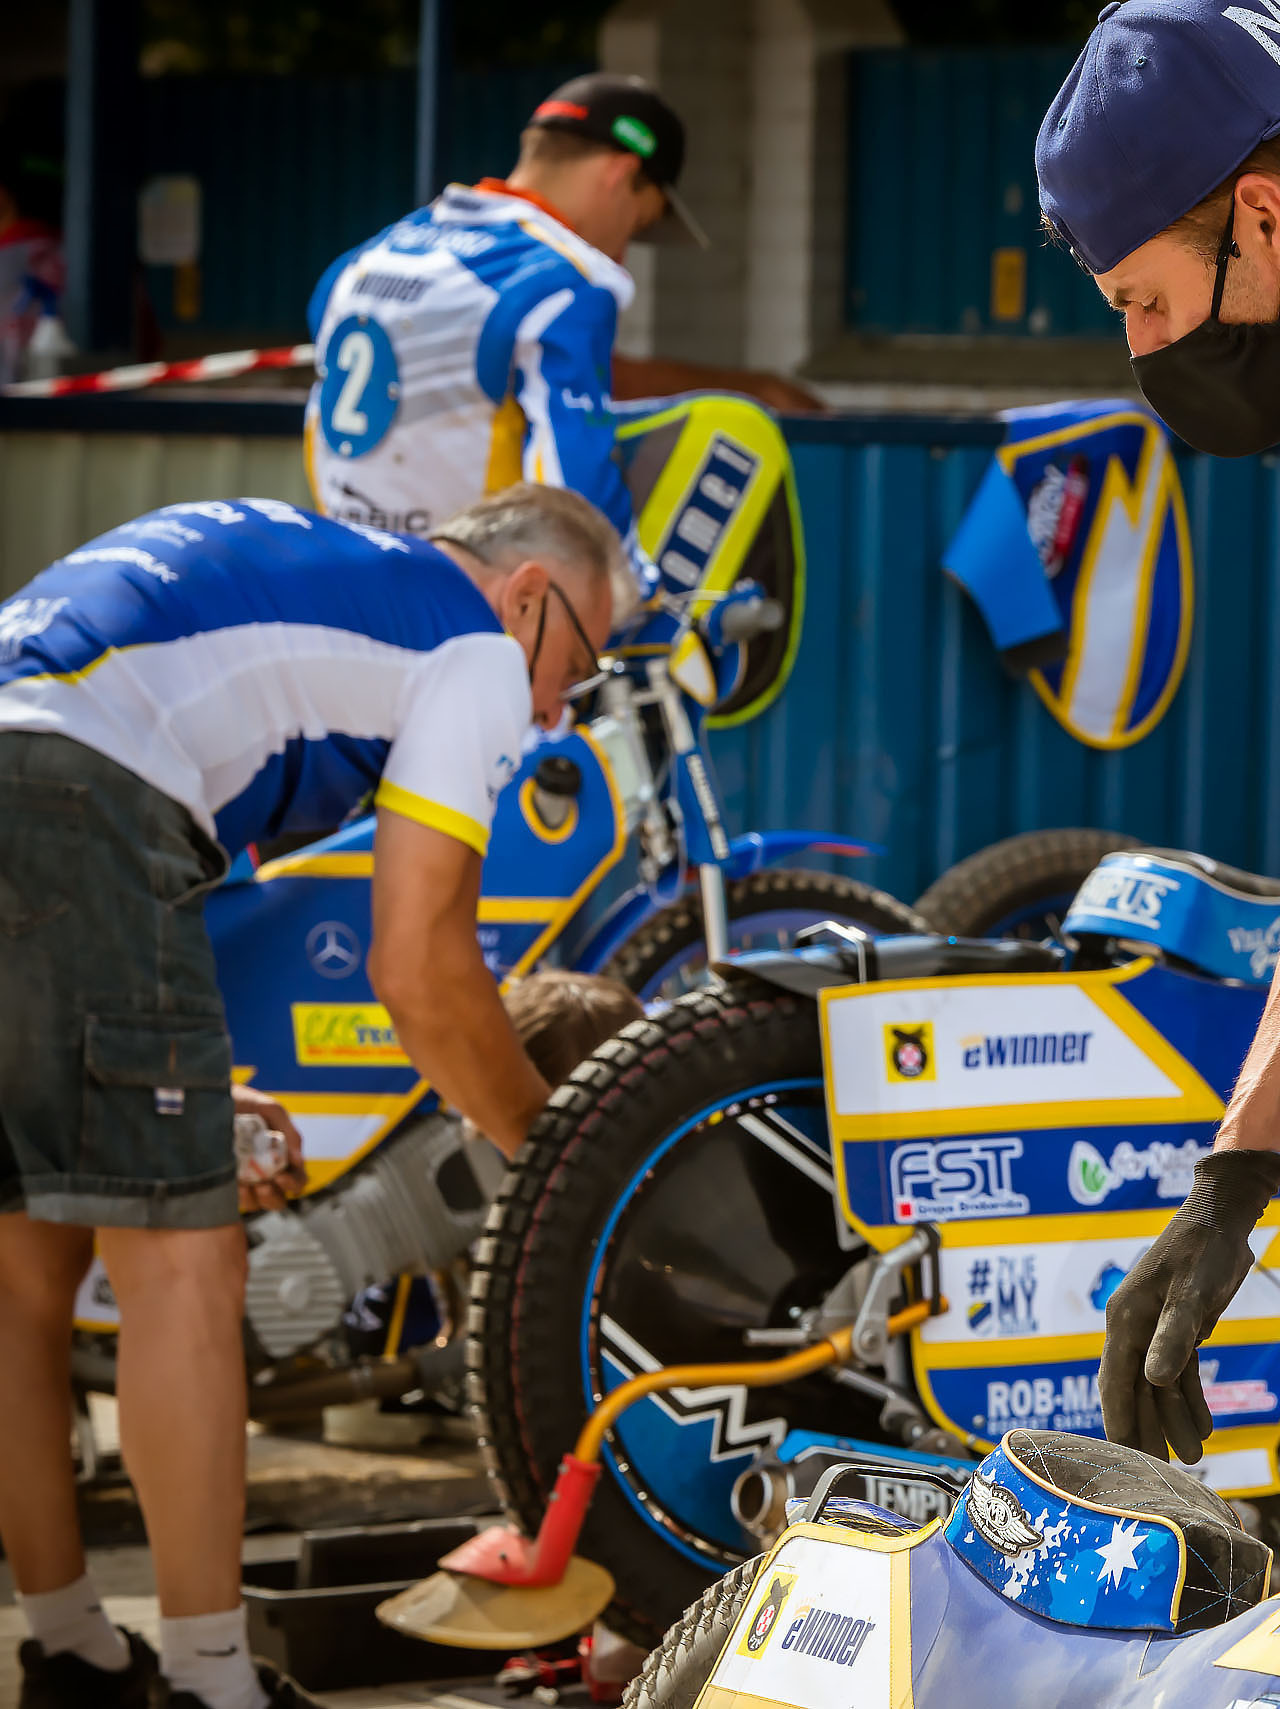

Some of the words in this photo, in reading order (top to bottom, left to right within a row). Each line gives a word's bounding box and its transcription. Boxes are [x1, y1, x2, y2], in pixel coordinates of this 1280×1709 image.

[332, 332, 374, 436] 2
[962, 1032, 1093, 1069] eWinner
[890, 1136, 1024, 1200] FST
[781, 1608, 876, 1667] eWinner
